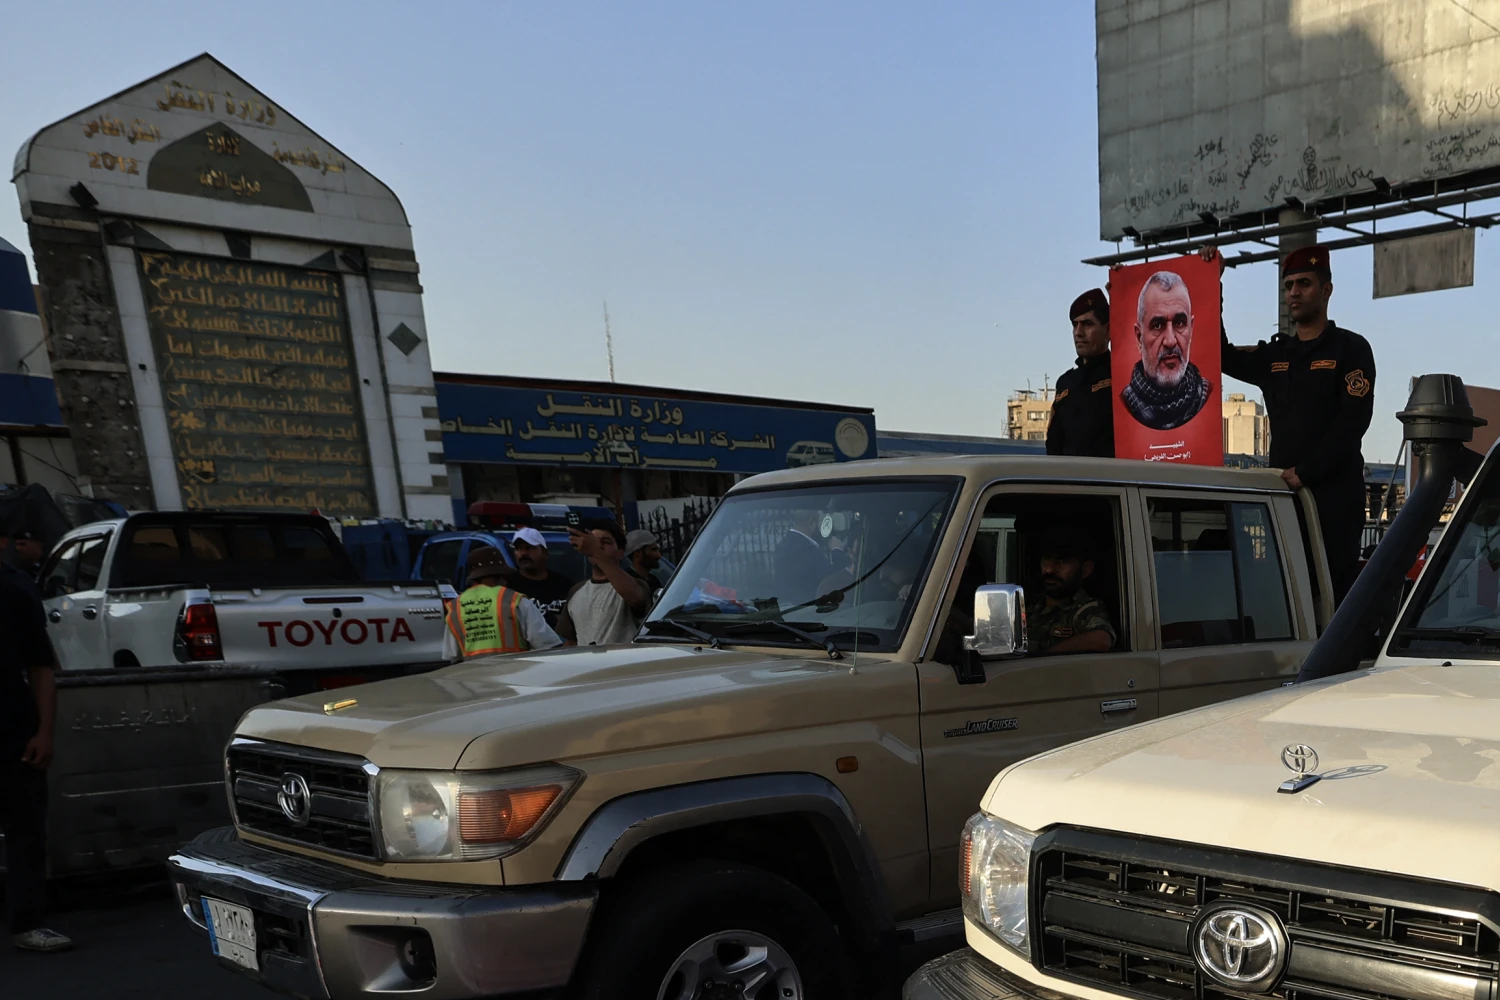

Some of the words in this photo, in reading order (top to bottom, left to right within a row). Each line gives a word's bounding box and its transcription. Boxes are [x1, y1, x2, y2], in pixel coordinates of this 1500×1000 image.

[157, 79, 215, 113] النقل
[87, 150, 140, 176] 2012
[536, 393, 623, 419] النقل
[629, 399, 684, 426] وزارة
[518, 421, 582, 440] النقل
[587, 423, 636, 445] لادارة
[640, 425, 706, 446] العامة
[709, 430, 775, 451] الشركة
[1149, 440, 1175, 450] الشهيد
[258, 617, 416, 647] TOYOTA
